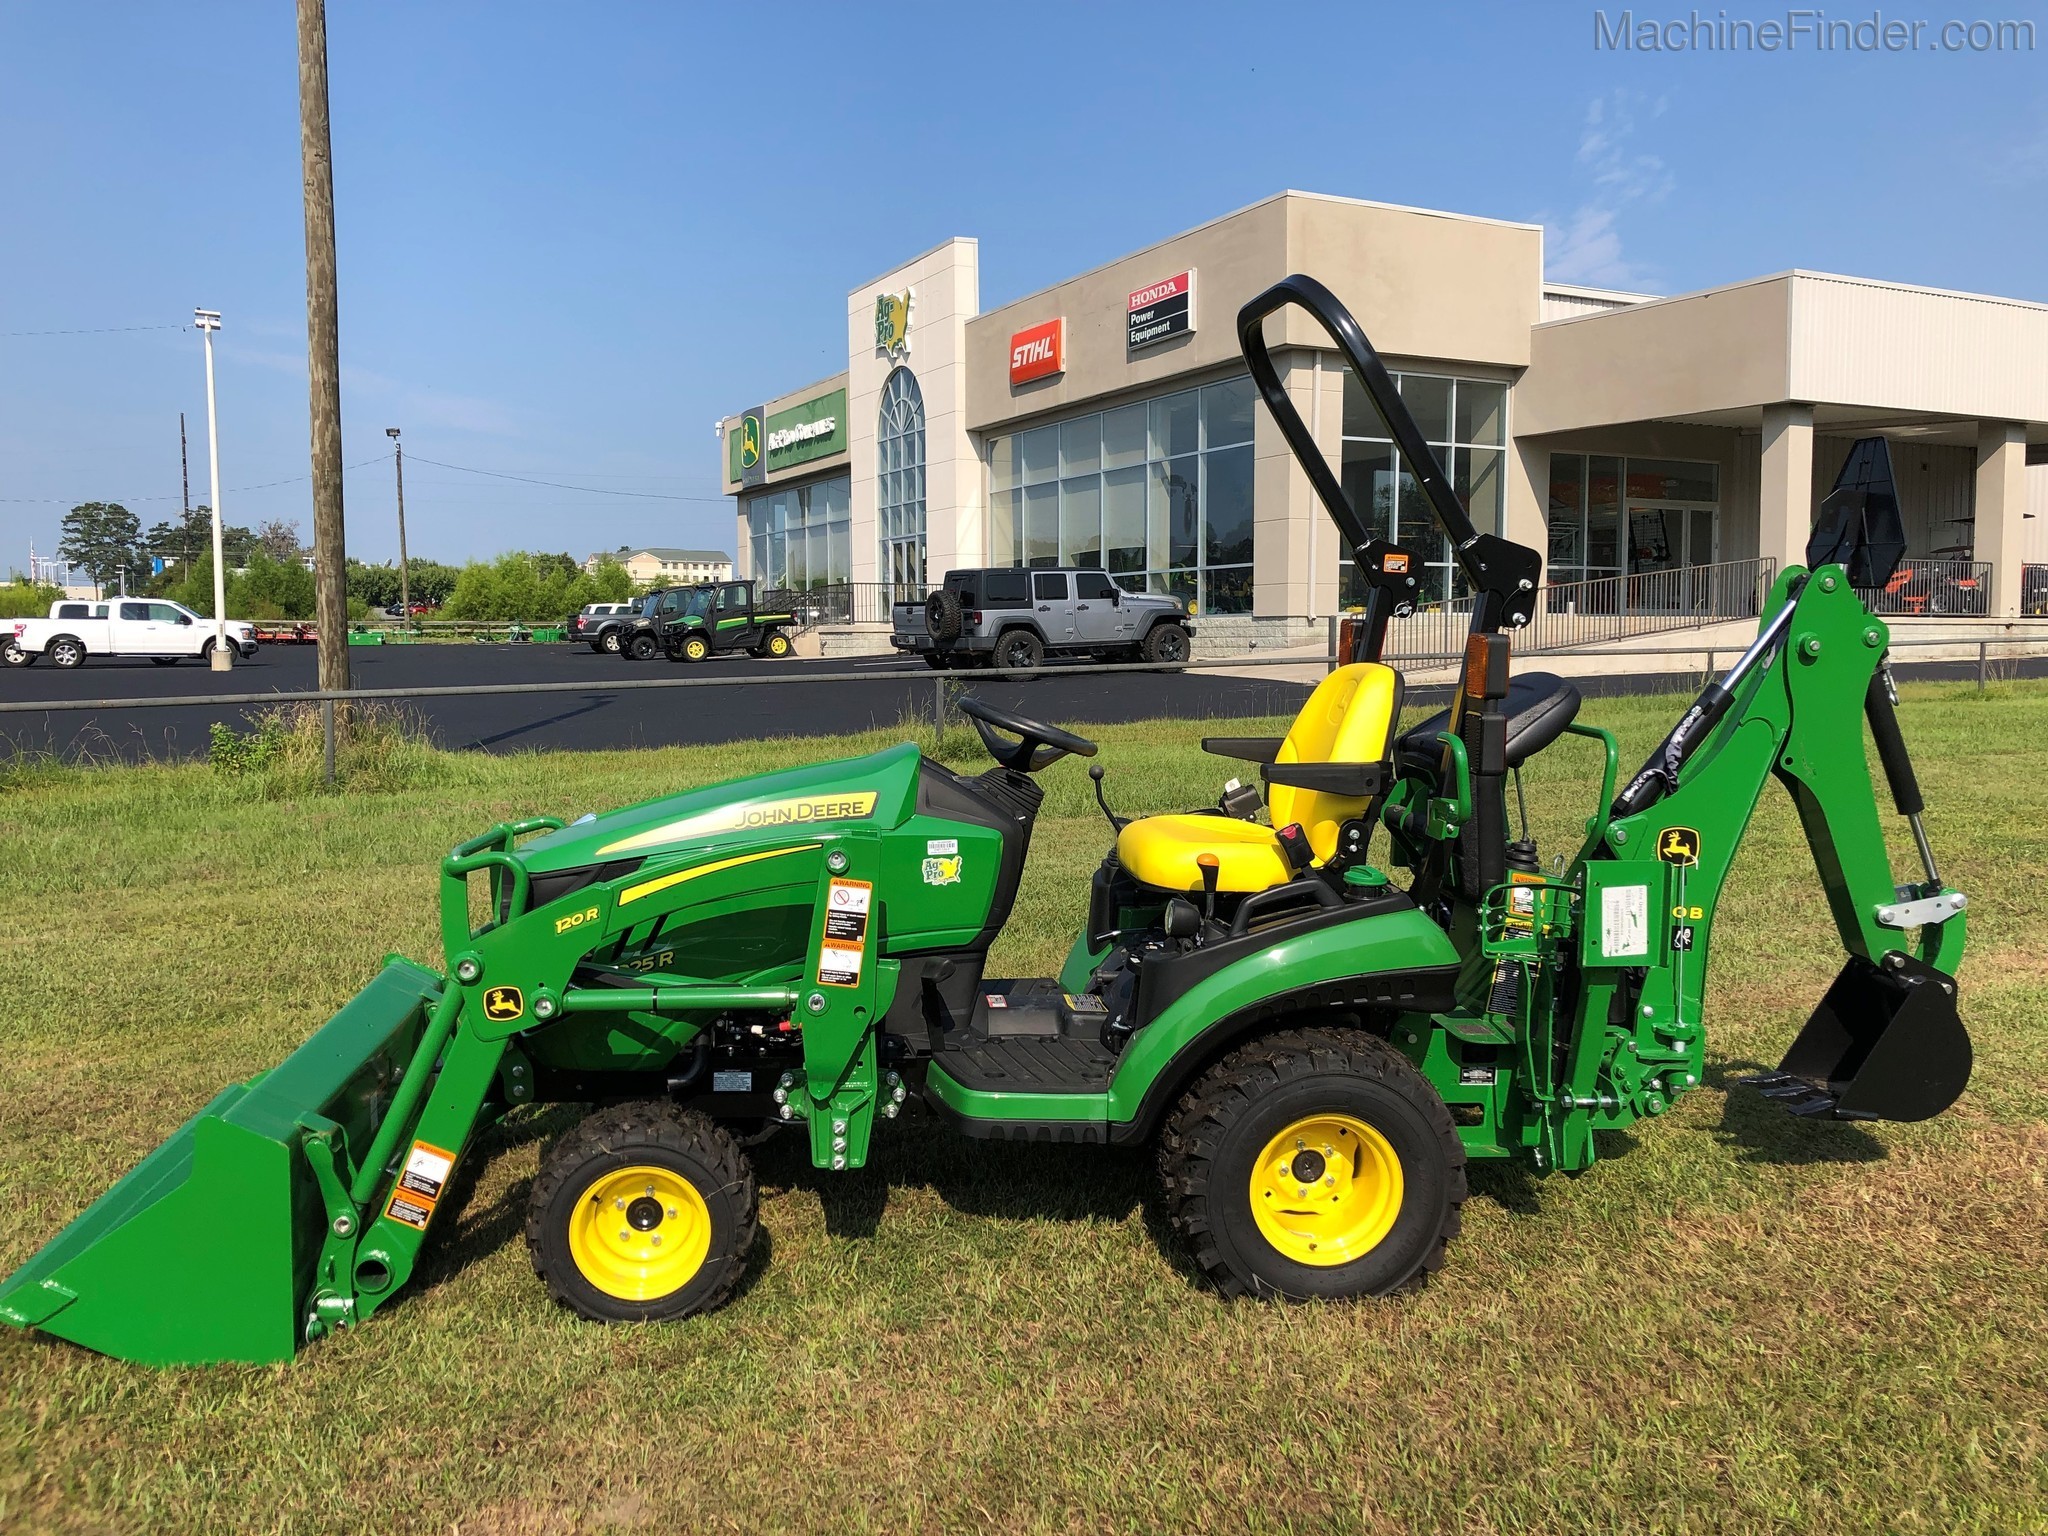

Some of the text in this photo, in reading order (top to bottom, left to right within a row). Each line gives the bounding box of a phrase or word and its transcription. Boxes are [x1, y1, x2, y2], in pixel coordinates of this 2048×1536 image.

[1130, 281, 1177, 308] HONDA
[1130, 308, 1155, 326] Power
[876, 320, 894, 347] Pro
[1130, 320, 1171, 344] Equipment
[1011, 335, 1055, 369] STIHL
[734, 801, 864, 828] JOHN DEERE
[839, 880, 870, 889] WARNING
[925, 870, 944, 880] Pro
[831, 942, 862, 951] WARNING
